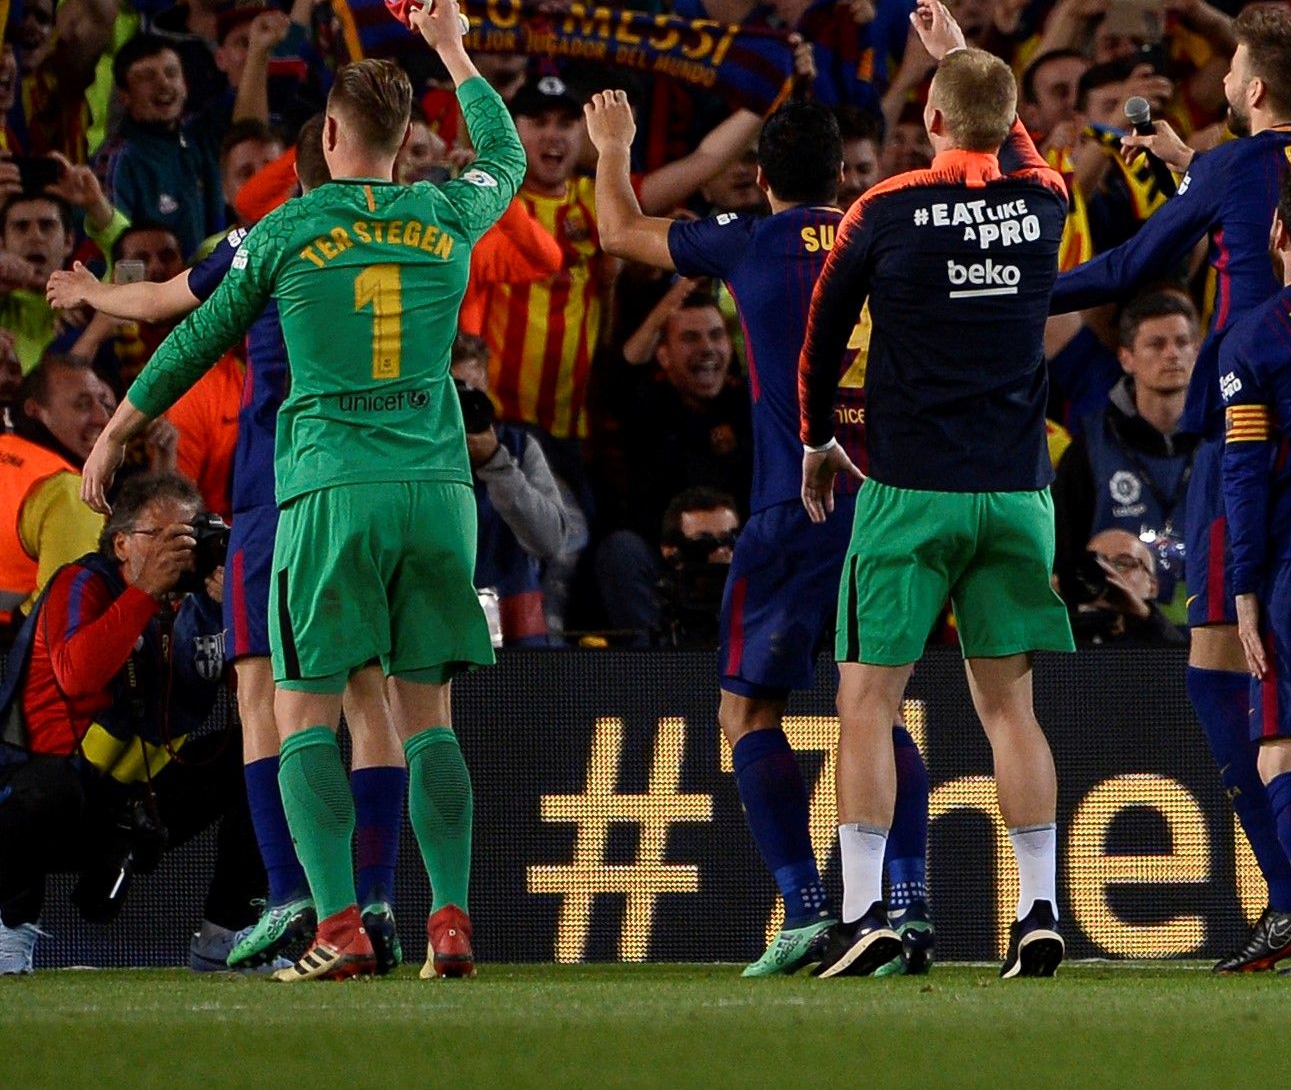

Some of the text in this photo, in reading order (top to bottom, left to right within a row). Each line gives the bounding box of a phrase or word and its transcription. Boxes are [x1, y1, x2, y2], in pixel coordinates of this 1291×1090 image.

[300, 226, 354, 269] TER
[352, 219, 456, 260] STEGEN
[978, 213, 1042, 250] PRO
[947, 258, 1022, 286] beko
[354, 263, 404, 380] 1
[338, 392, 405, 412] unicef
